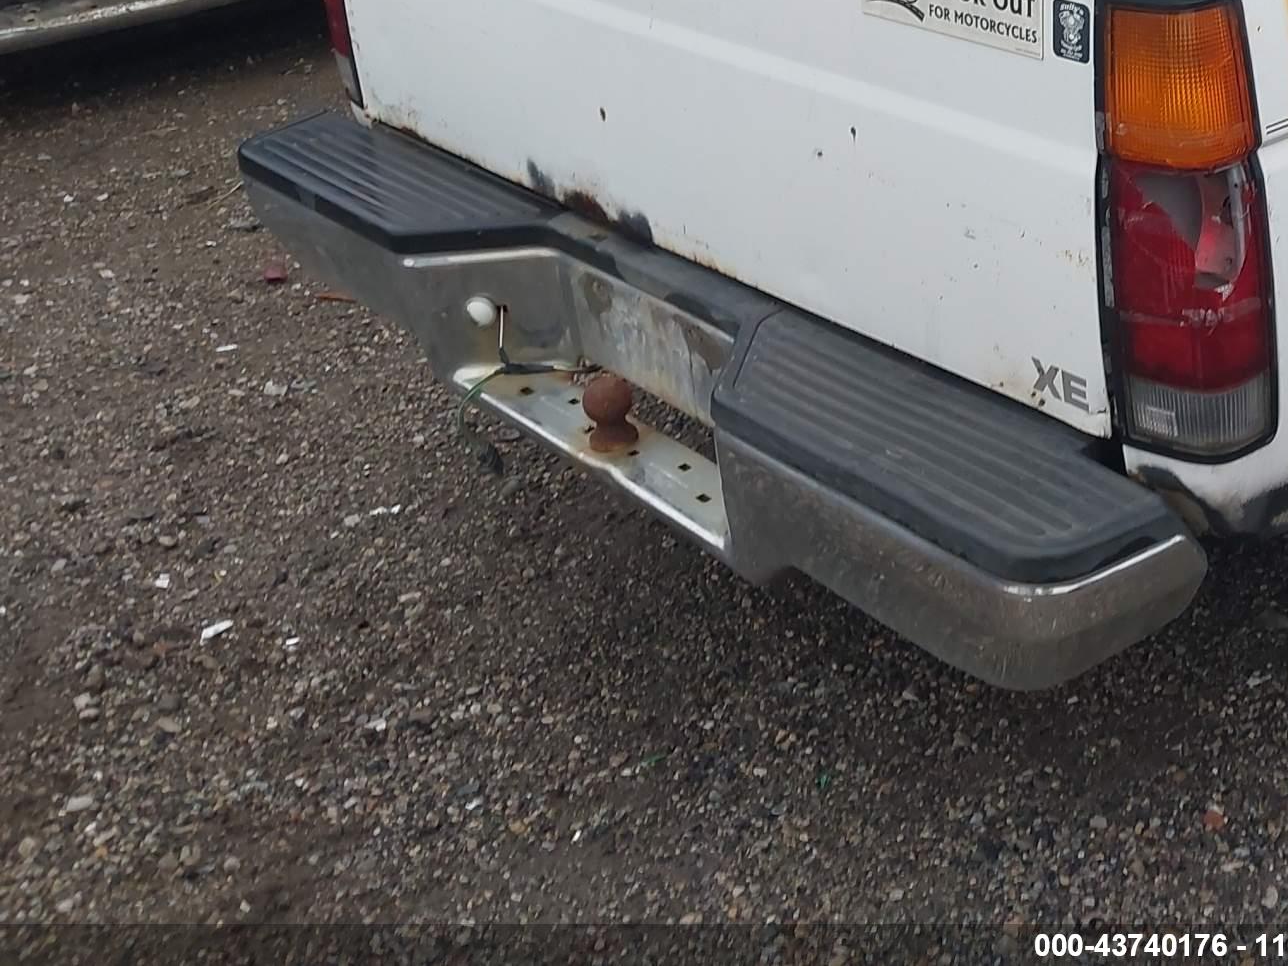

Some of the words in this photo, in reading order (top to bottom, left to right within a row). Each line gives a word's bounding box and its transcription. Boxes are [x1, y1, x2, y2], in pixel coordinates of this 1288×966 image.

[929, 4, 951, 21] FOR
[954, 12, 1038, 44] MOTORCYCLES
[1031, 356, 1090, 414] XE
